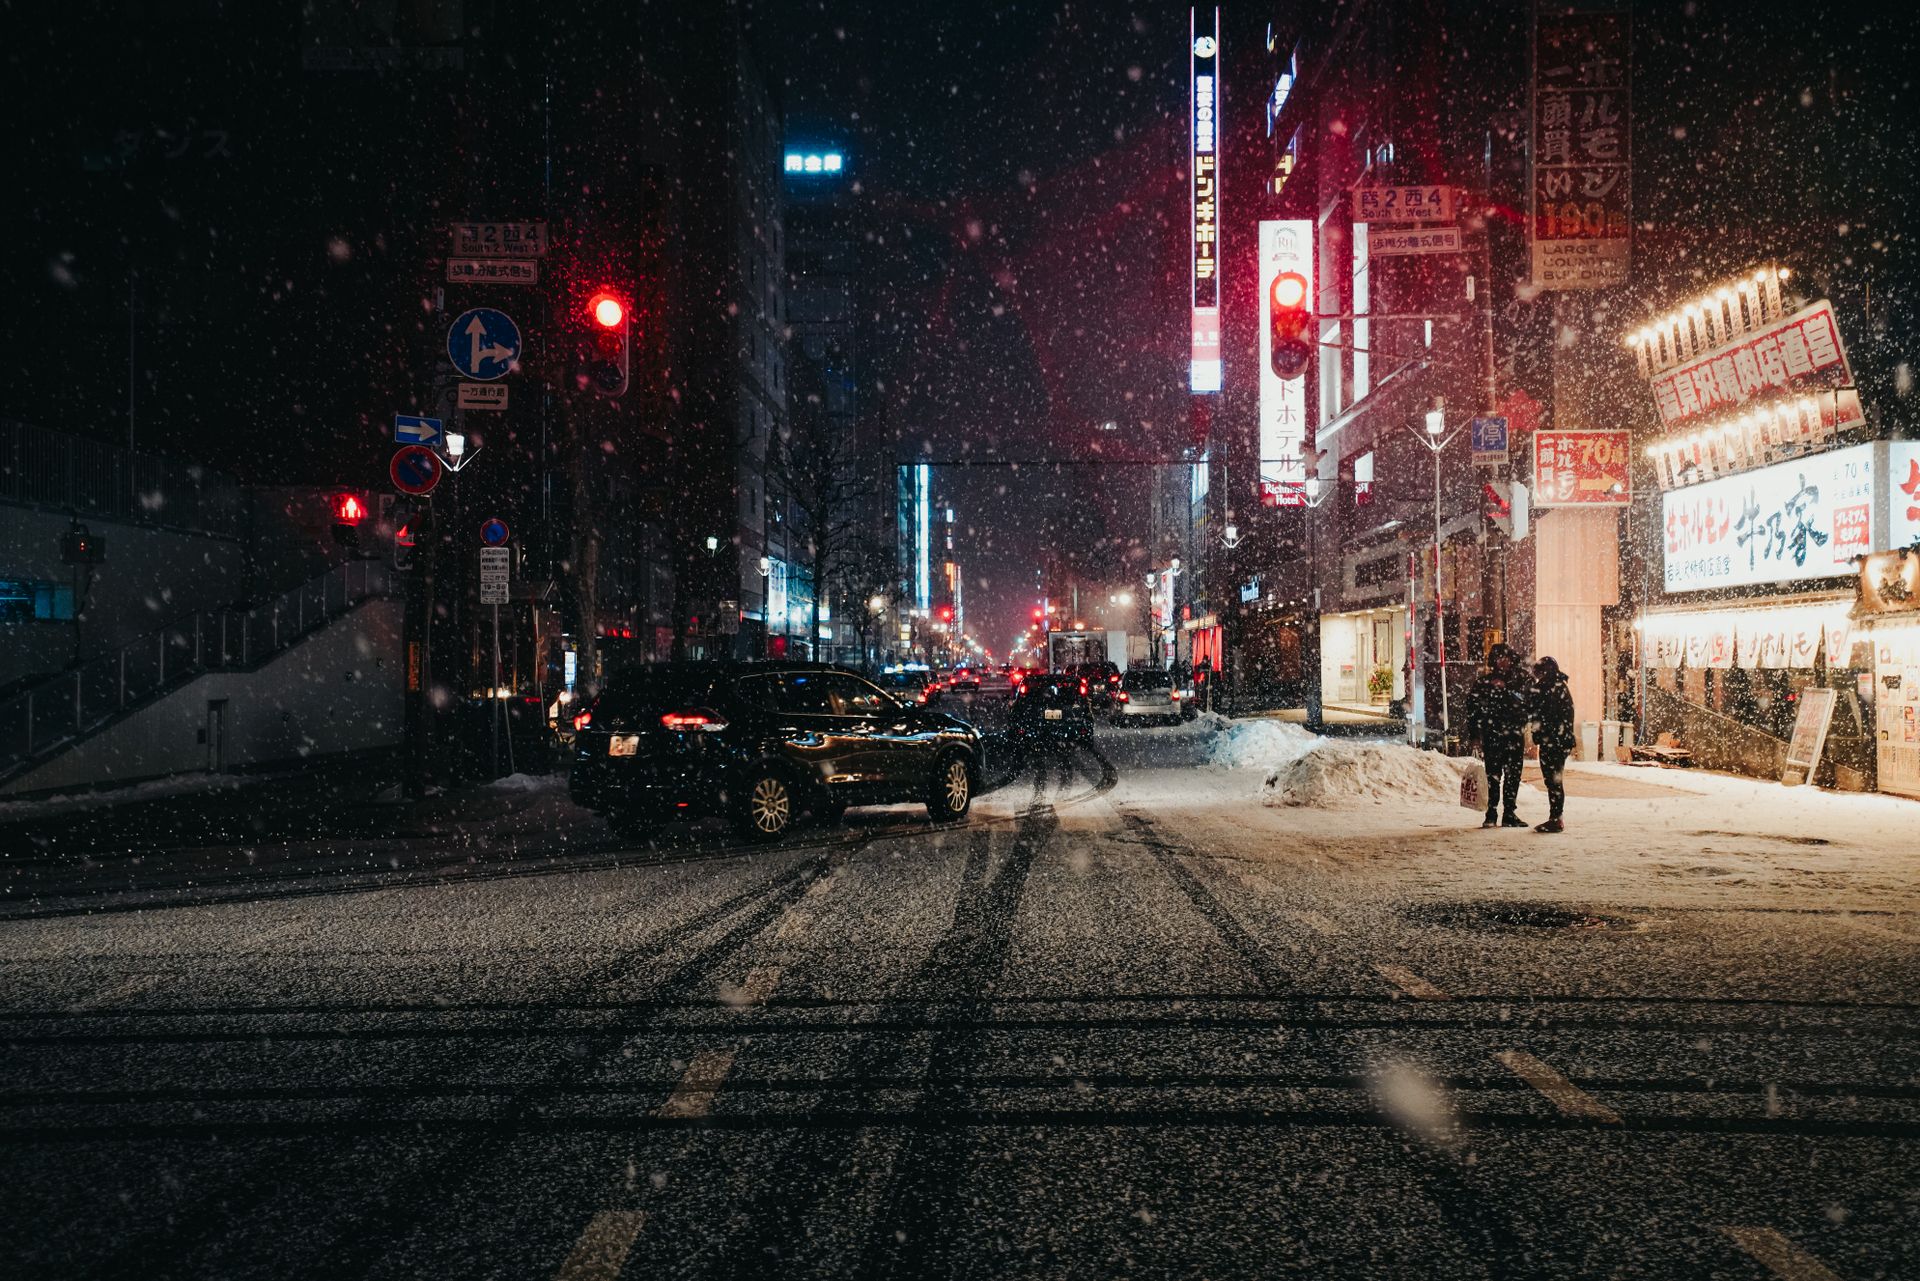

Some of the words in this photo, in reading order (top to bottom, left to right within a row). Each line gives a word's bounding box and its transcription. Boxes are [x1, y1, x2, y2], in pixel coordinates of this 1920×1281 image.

[1362, 208, 1392, 218] South
[1405, 208, 1430, 217] West
[462, 243, 489, 252] South
[1543, 245, 1598, 255] LARGE
[1543, 271, 1620, 280] BUIDING
[1276, 494, 1301, 505] Hotel
[1733, 473, 1829, 572] 牛乃家
